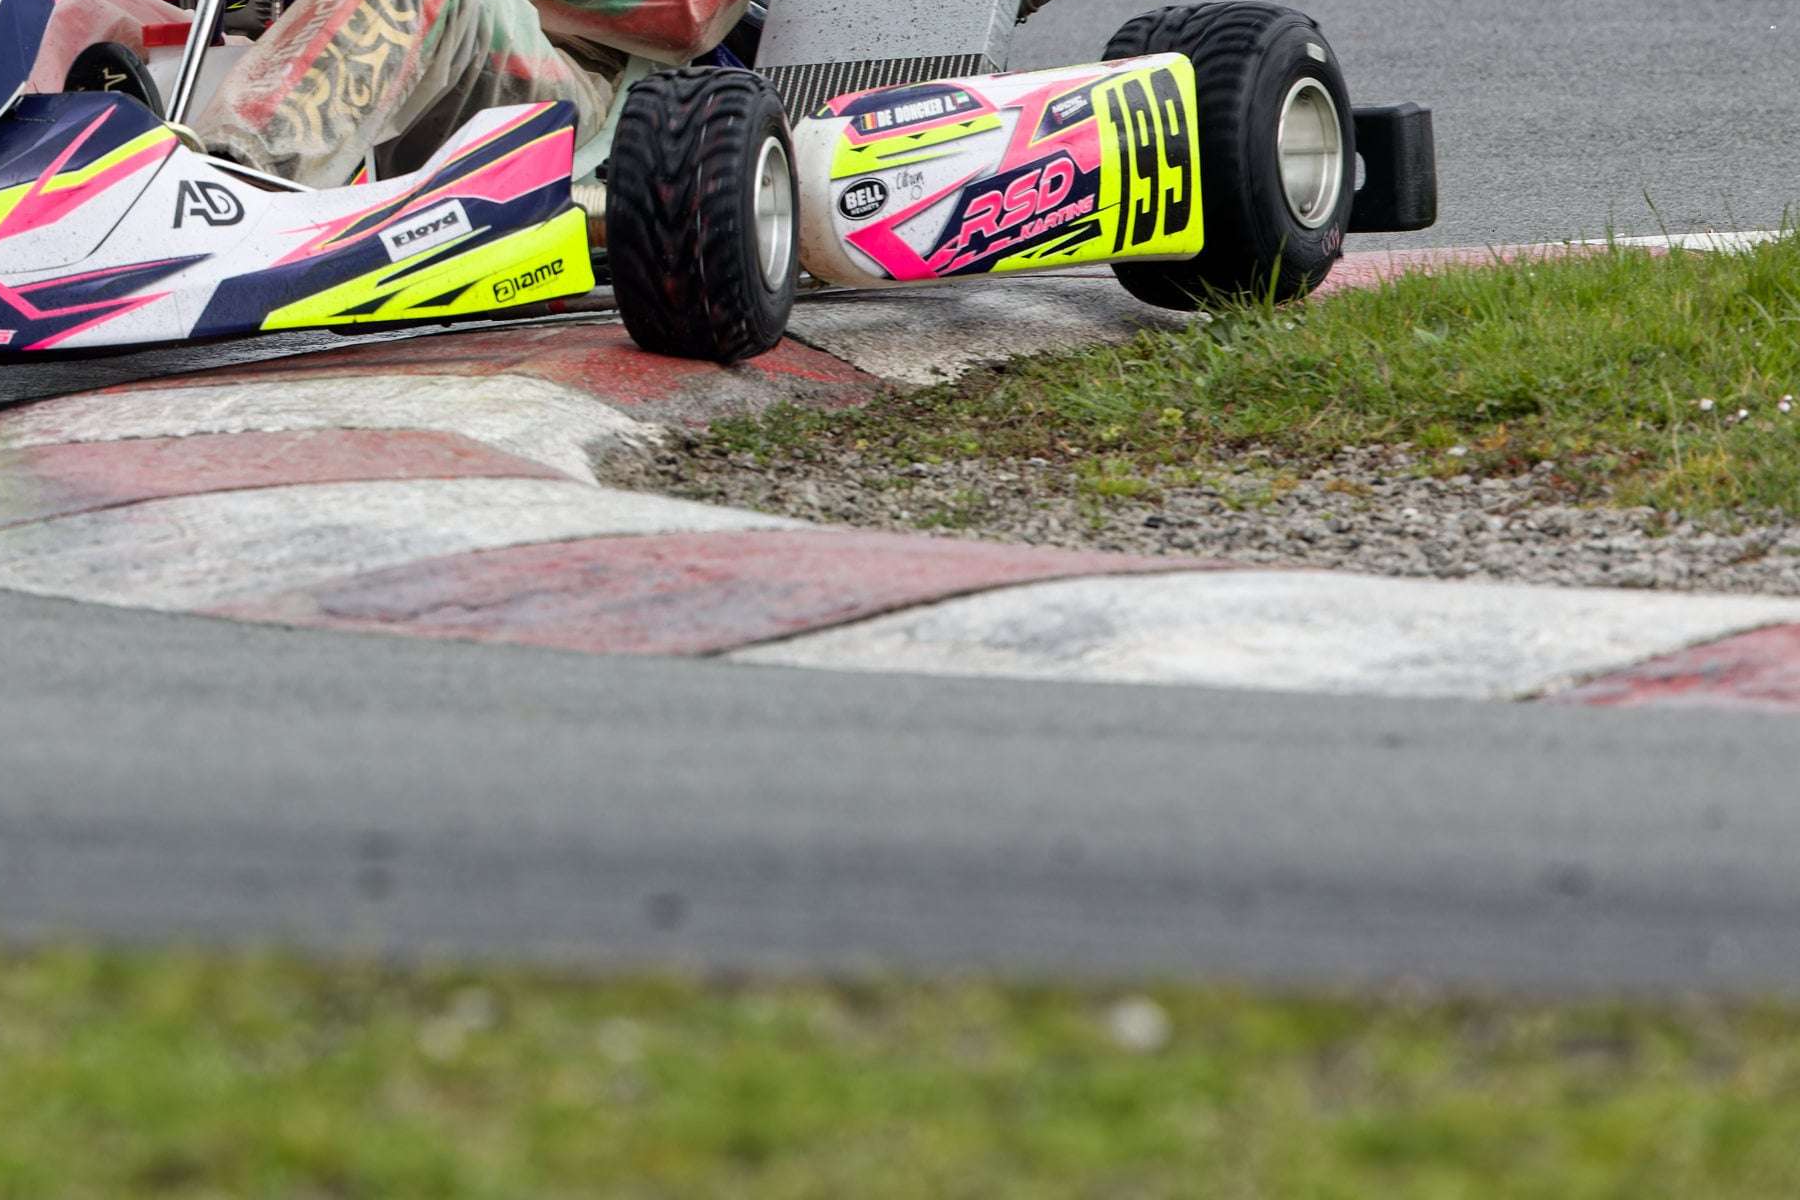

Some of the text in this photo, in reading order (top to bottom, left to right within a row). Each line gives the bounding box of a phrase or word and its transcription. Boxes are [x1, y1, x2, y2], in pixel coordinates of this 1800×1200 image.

[1105, 67, 1193, 254] 199
[844, 184, 885, 211] BELL
[957, 156, 1075, 250] RSD
[1019, 194, 1095, 238] KARTING
[391, 210, 460, 249] Floyd
